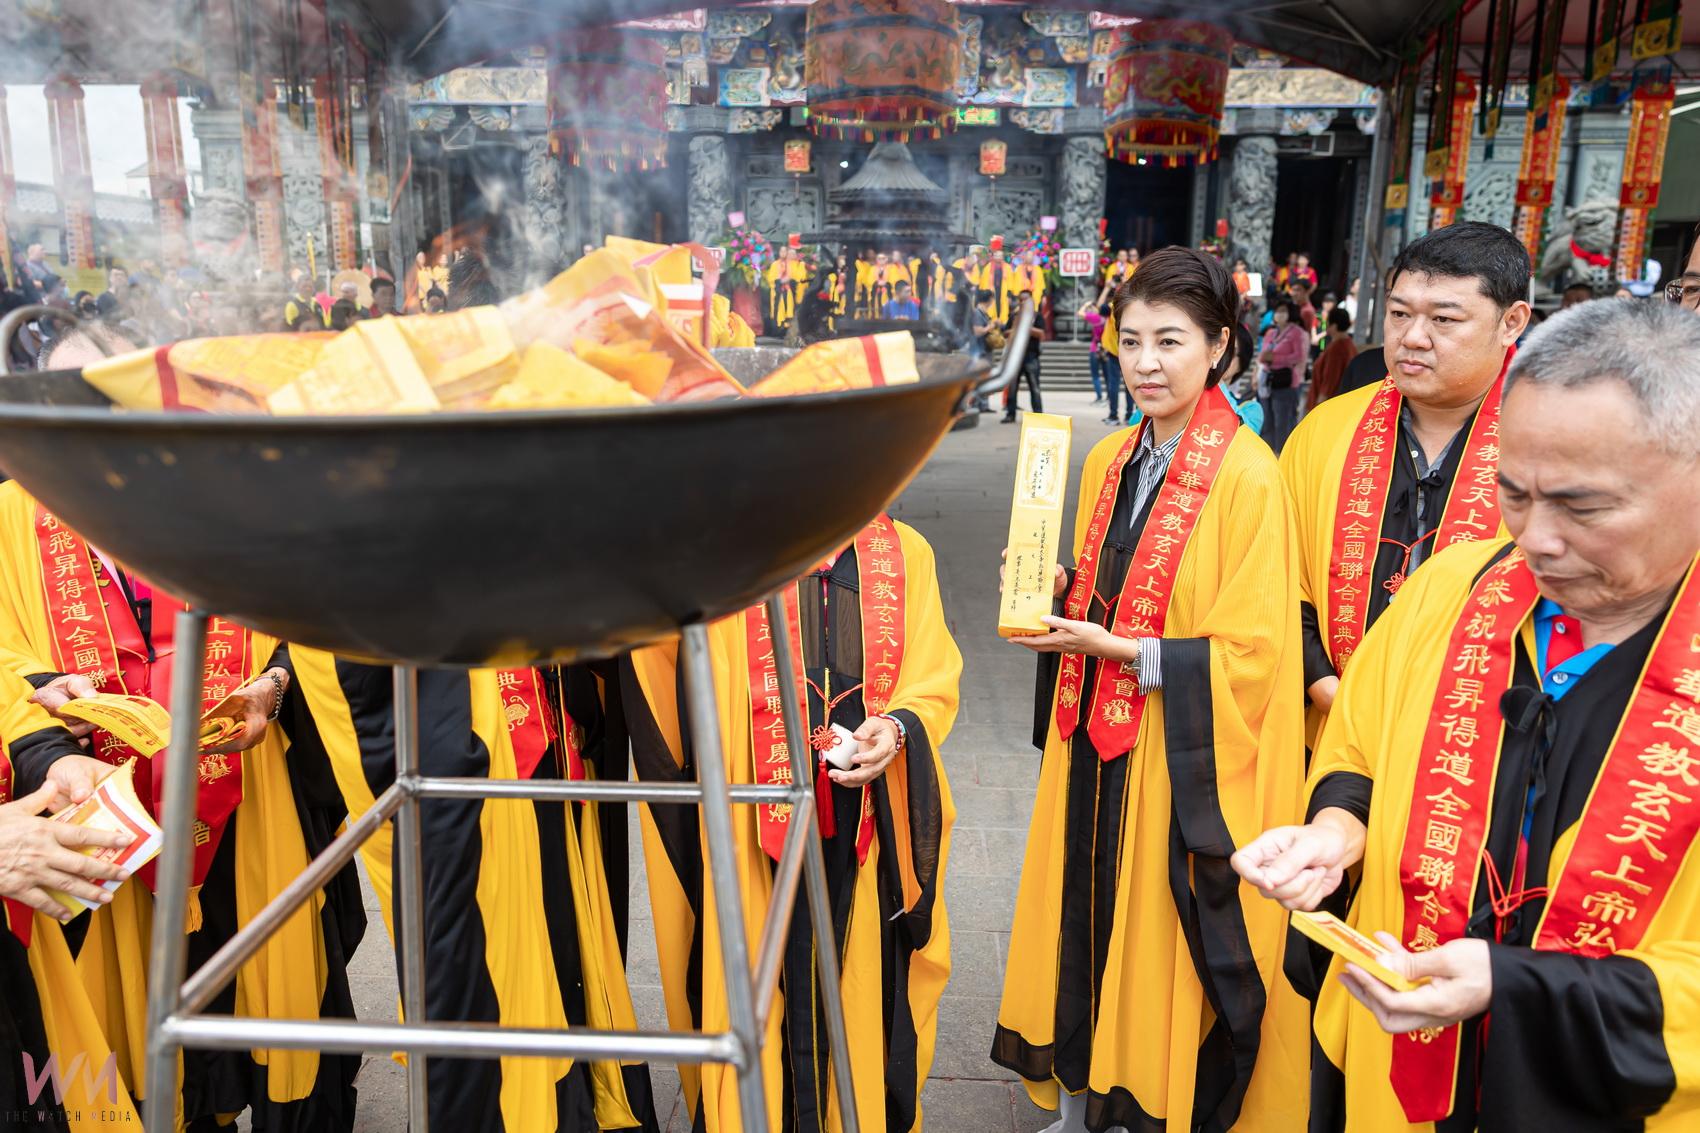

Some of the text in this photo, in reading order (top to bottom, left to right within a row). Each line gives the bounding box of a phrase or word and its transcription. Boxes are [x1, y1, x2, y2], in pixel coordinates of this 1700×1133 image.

[1112, 450, 1211, 697] 中華道教玄天上帝弘會
